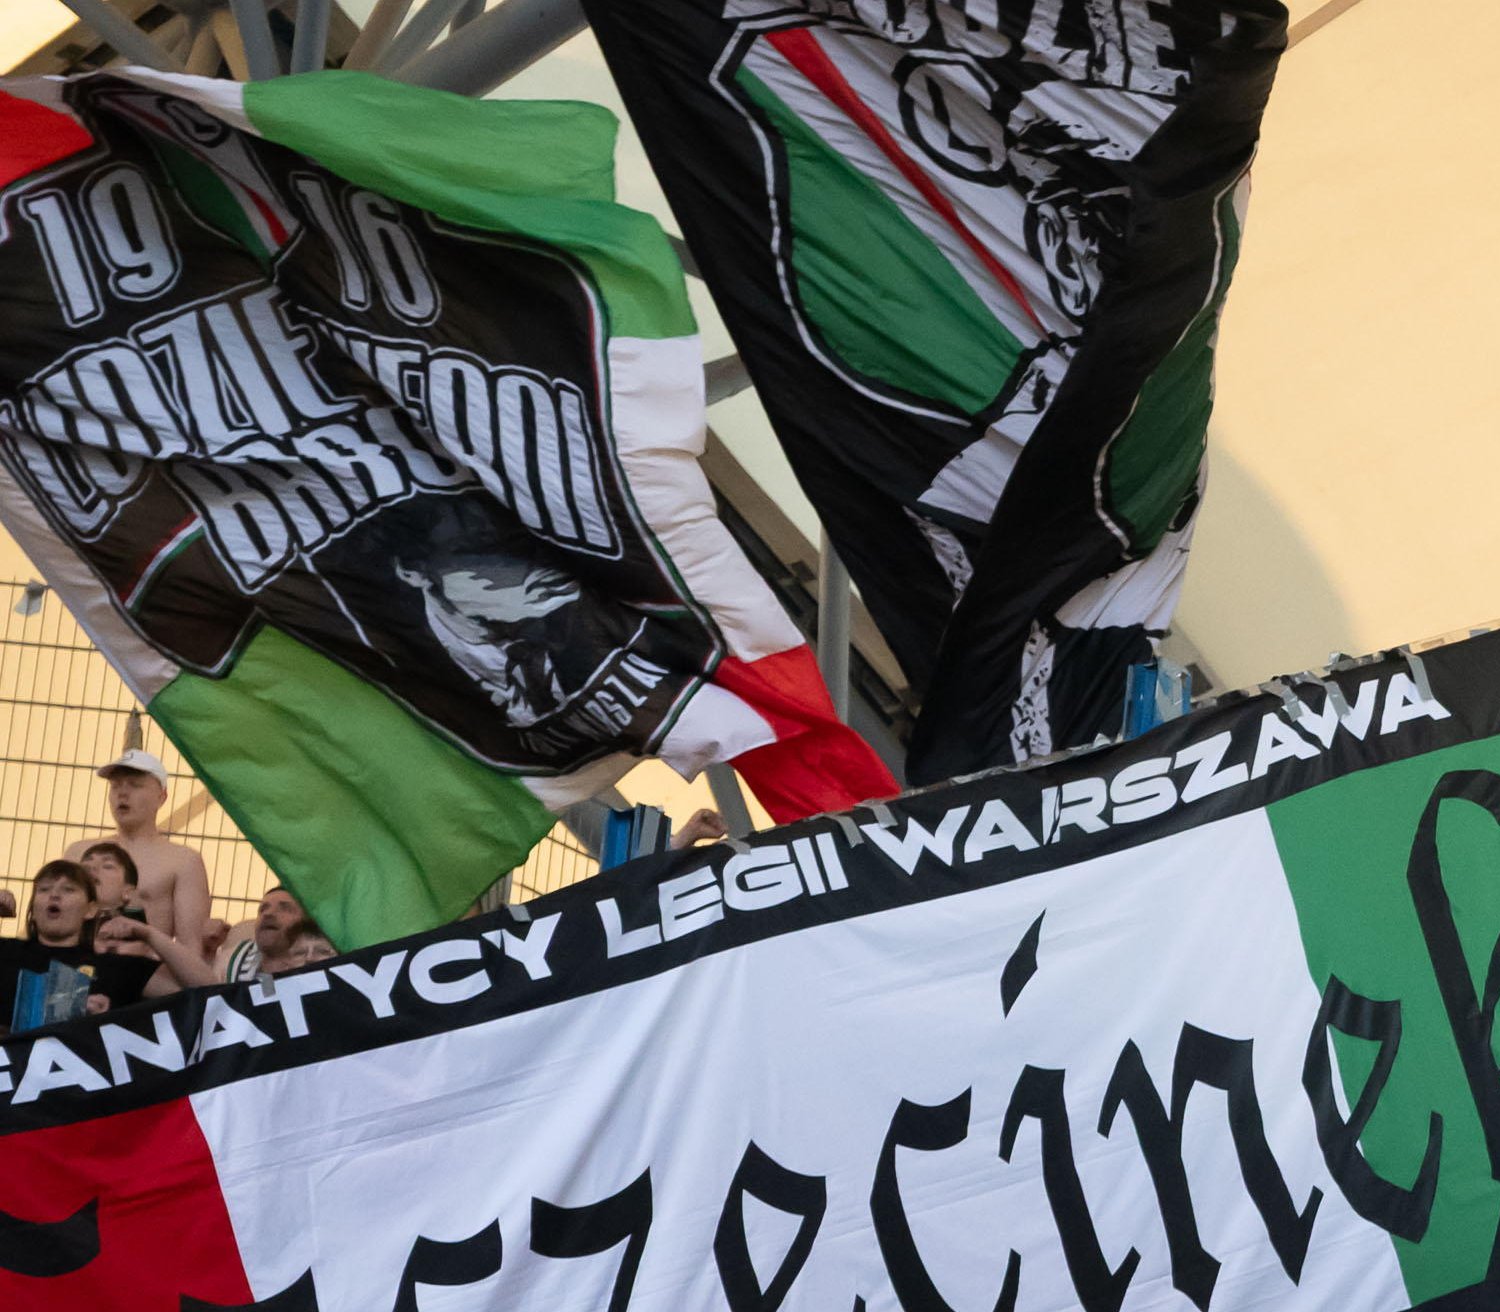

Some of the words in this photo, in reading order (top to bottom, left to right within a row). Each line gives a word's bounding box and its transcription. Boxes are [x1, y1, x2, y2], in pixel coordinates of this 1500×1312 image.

[24, 168, 178, 325] 19
[294, 177, 439, 322] 16
[0, 912, 563, 1104] ANATYCY
[598, 832, 850, 959] LEGII
[863, 673, 1451, 877] WARSZAWA
